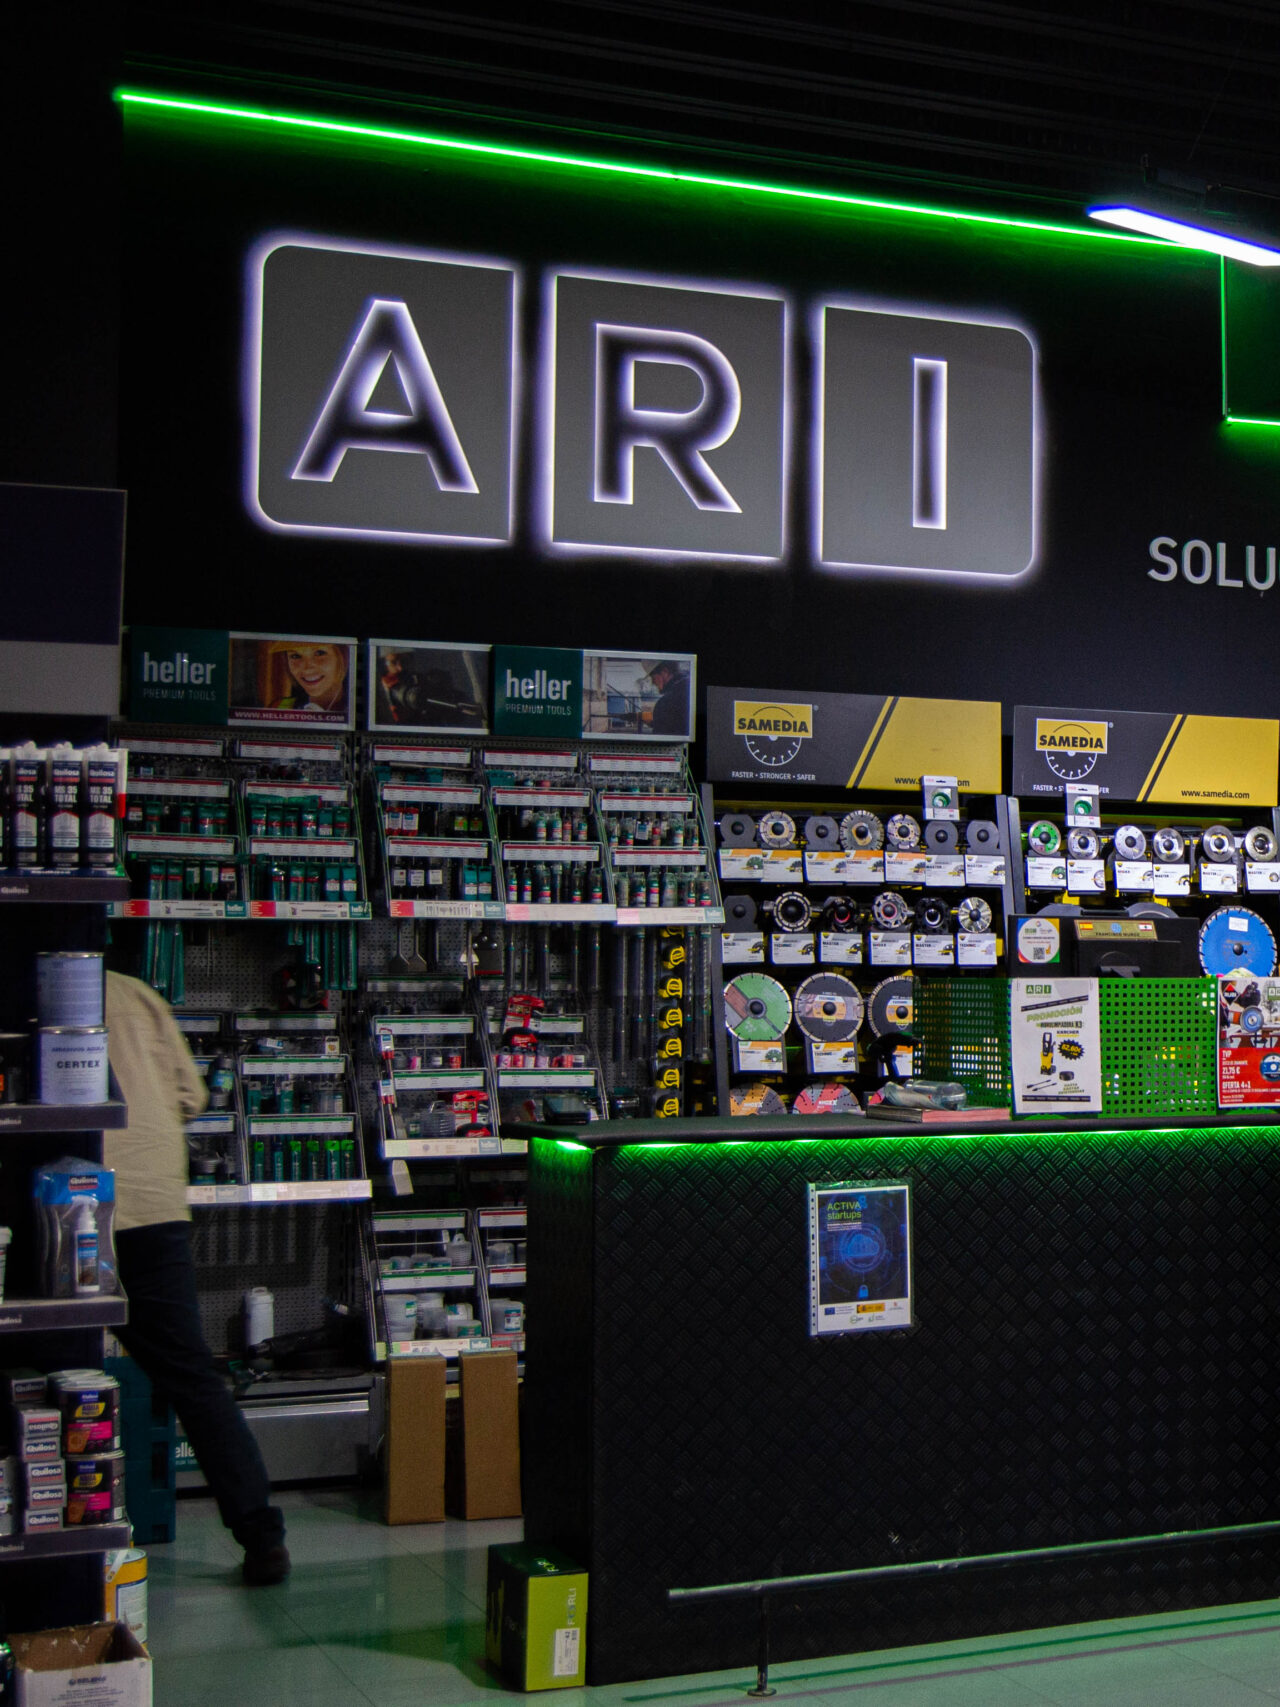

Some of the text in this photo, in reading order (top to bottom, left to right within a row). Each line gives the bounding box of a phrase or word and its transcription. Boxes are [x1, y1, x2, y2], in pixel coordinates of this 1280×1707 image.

[291, 299, 947, 530] ARI
[143, 651, 217, 685] heller
[505, 668, 572, 702] heller
[143, 688, 217, 701] PREMIUM TOOLS
[505, 702, 572, 716] PREMIUM TOOLS
[234, 710, 346, 722] WWW.HELLERTOOLS.COM
[737, 717, 809, 734] SAMEDIA
[1038, 734, 1105, 750] SAMEDIA
[731, 771, 816, 781] FASTER STRONGER SAFER
[1032, 784, 1054, 792] FASTER
[1180, 788, 1251, 800] www.samedia.com
[1027, 985, 1051, 994] ARI
[1026, 1006, 1083, 1022] PROMOCIÓN
[56, 1061, 100, 1069] CERTEX
[827, 1201, 861, 1211] ACTIVA
[827, 1211, 862, 1222] startups
[15, 1382, 44, 1393] Quilosa
[26, 1443, 57, 1453] Quilosa
[31, 1467, 62, 1477] Quilosa
[32, 1490, 63, 1501] Quilosa
[28, 1515, 59, 1525] Quilosa
